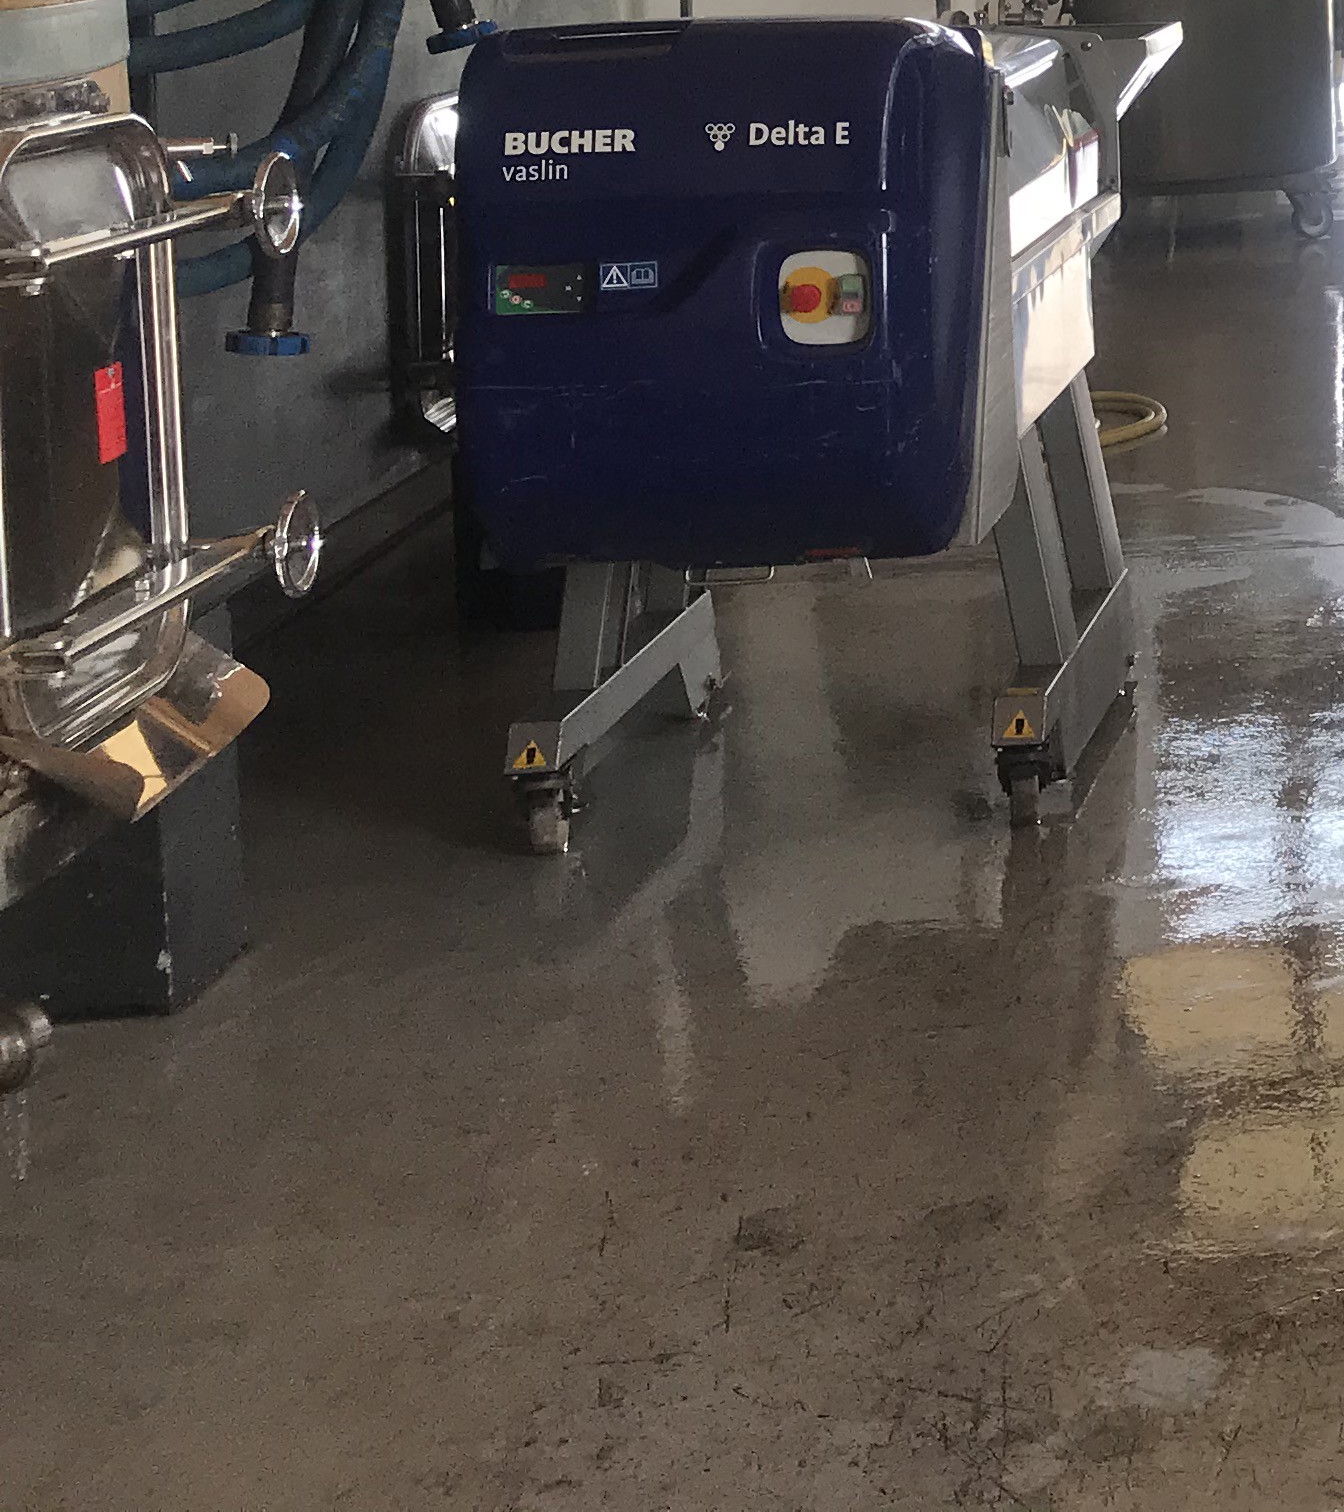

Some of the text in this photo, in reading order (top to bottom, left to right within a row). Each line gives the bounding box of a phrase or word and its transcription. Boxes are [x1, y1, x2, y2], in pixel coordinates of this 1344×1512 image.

[504, 129, 635, 155] BUCHER
[749, 120, 850, 146] Delta E
[502, 161, 568, 181] vaslin
